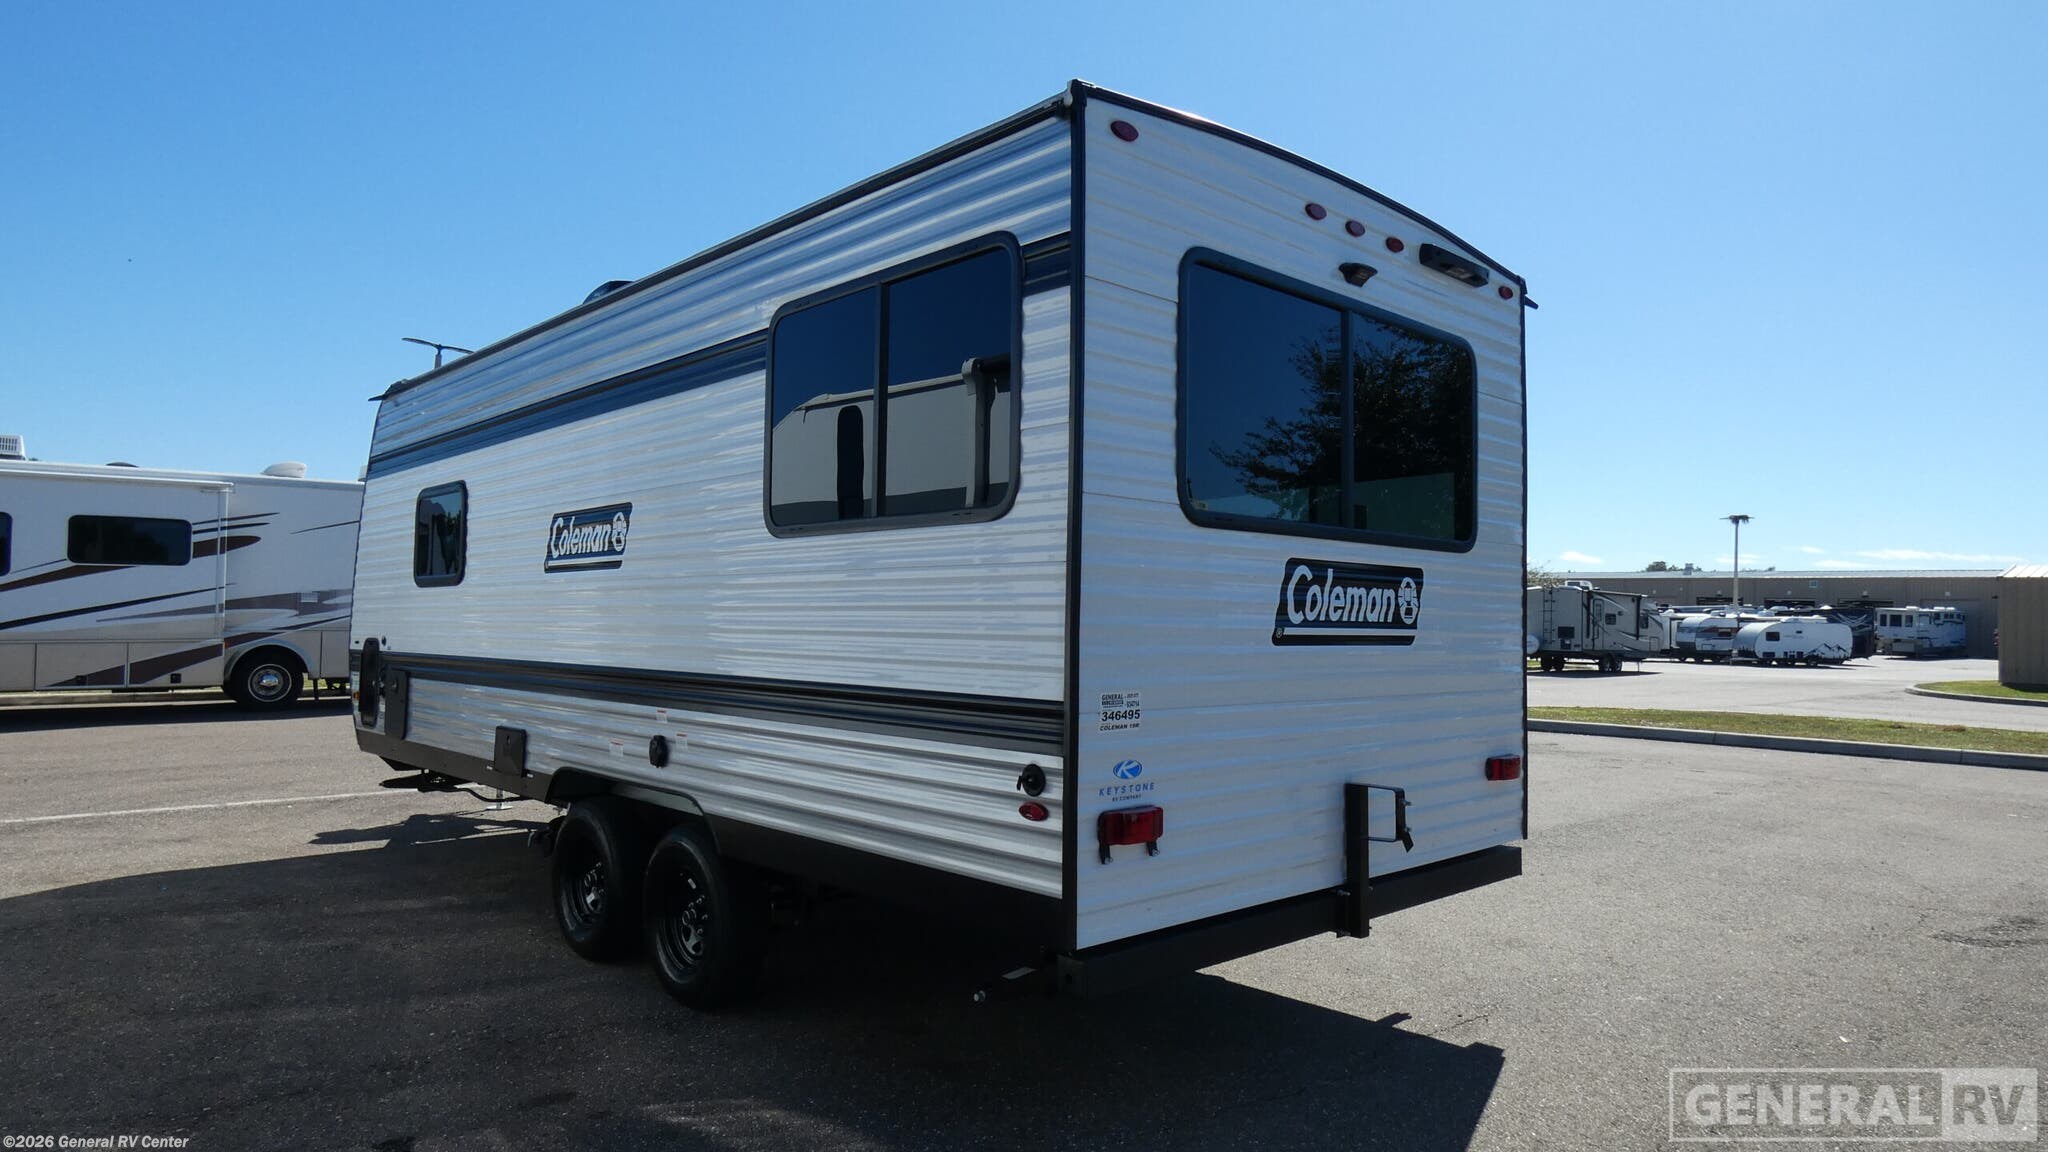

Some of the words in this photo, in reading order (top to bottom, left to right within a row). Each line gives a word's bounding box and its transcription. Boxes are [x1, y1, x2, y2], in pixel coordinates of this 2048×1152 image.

[550, 517, 611, 558] Coleman
[1287, 565, 1395, 624] Coleman
[1101, 710, 1140, 721] 346495
[1099, 782, 1155, 796] KEYSTONE
